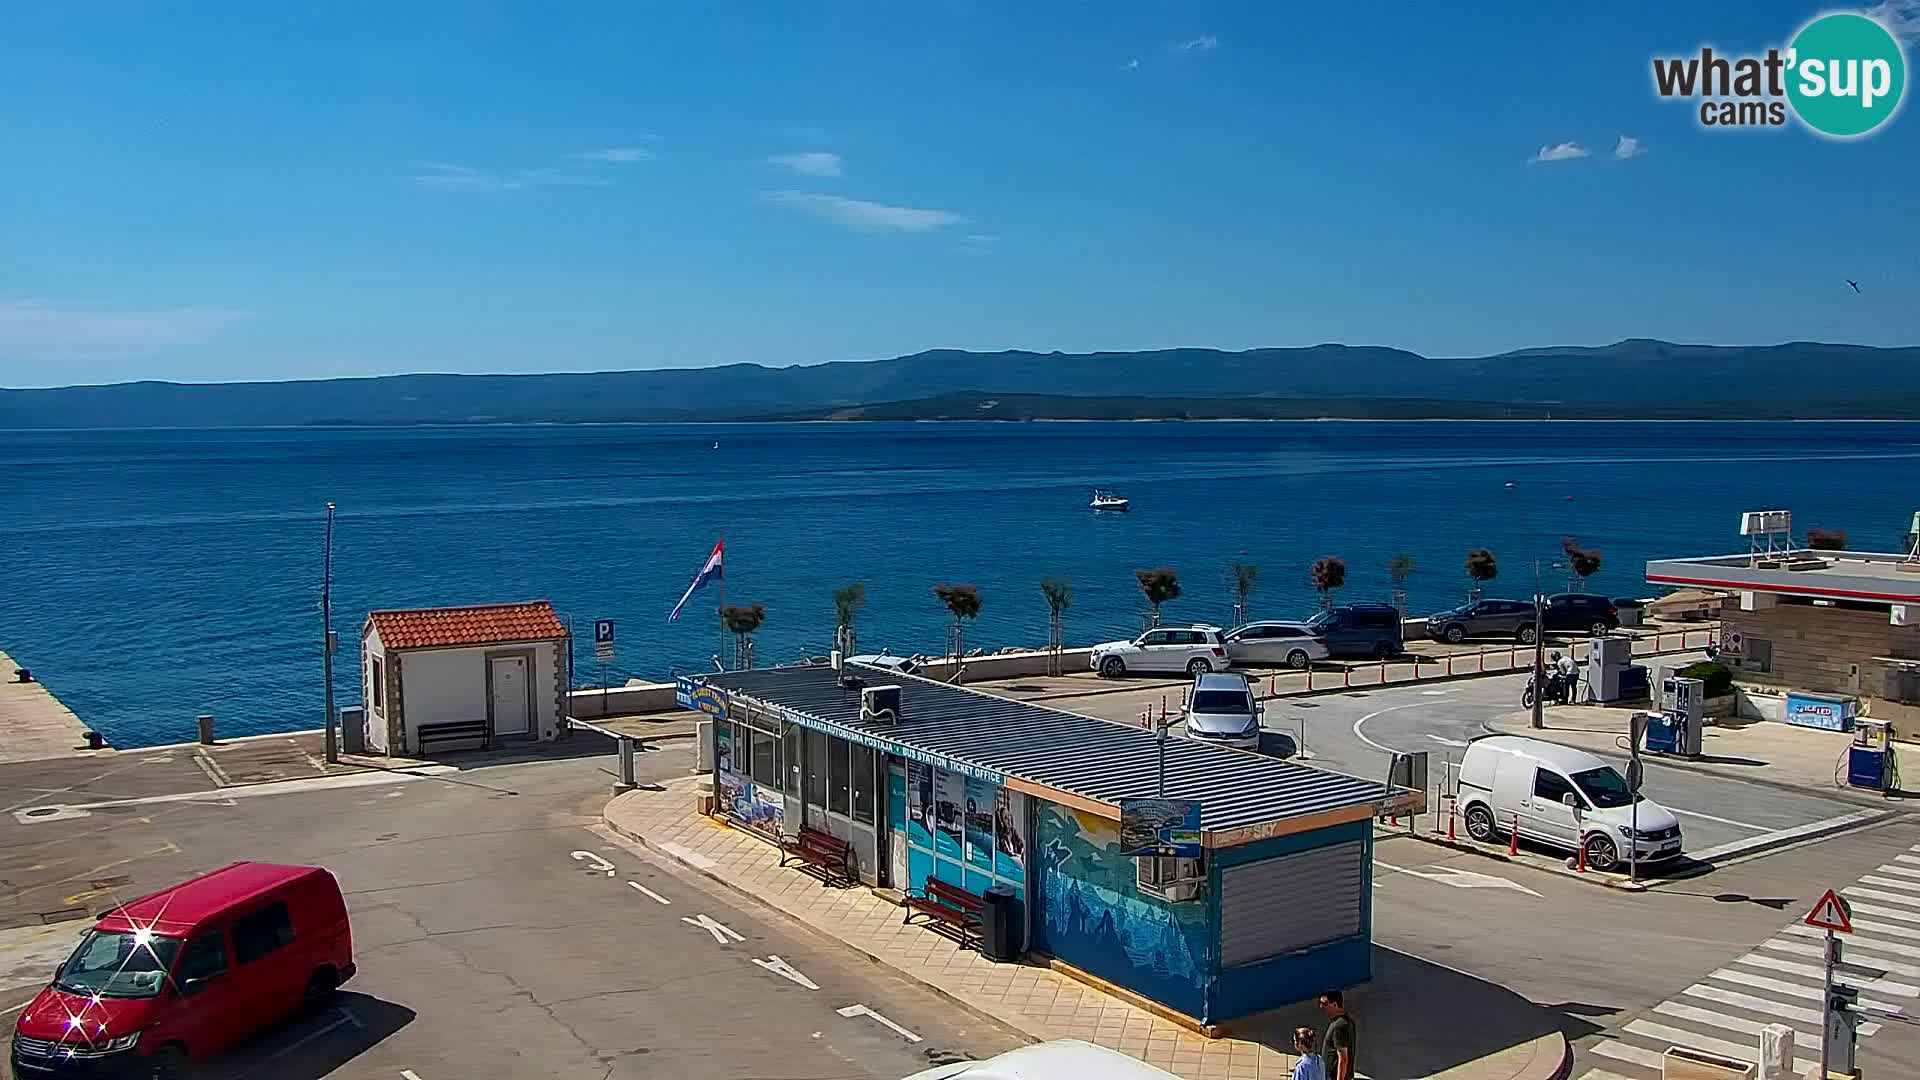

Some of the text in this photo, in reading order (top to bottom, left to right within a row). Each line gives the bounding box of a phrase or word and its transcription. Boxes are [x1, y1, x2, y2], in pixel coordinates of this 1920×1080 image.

[599, 622, 610, 639] P
[864, 735, 893, 753] POSTAJA
[902, 747, 916, 760] BUS
[917, 751, 947, 769] STATION
[949, 760, 974, 777] TICKET
[975, 768, 1001, 784] OFFICE
